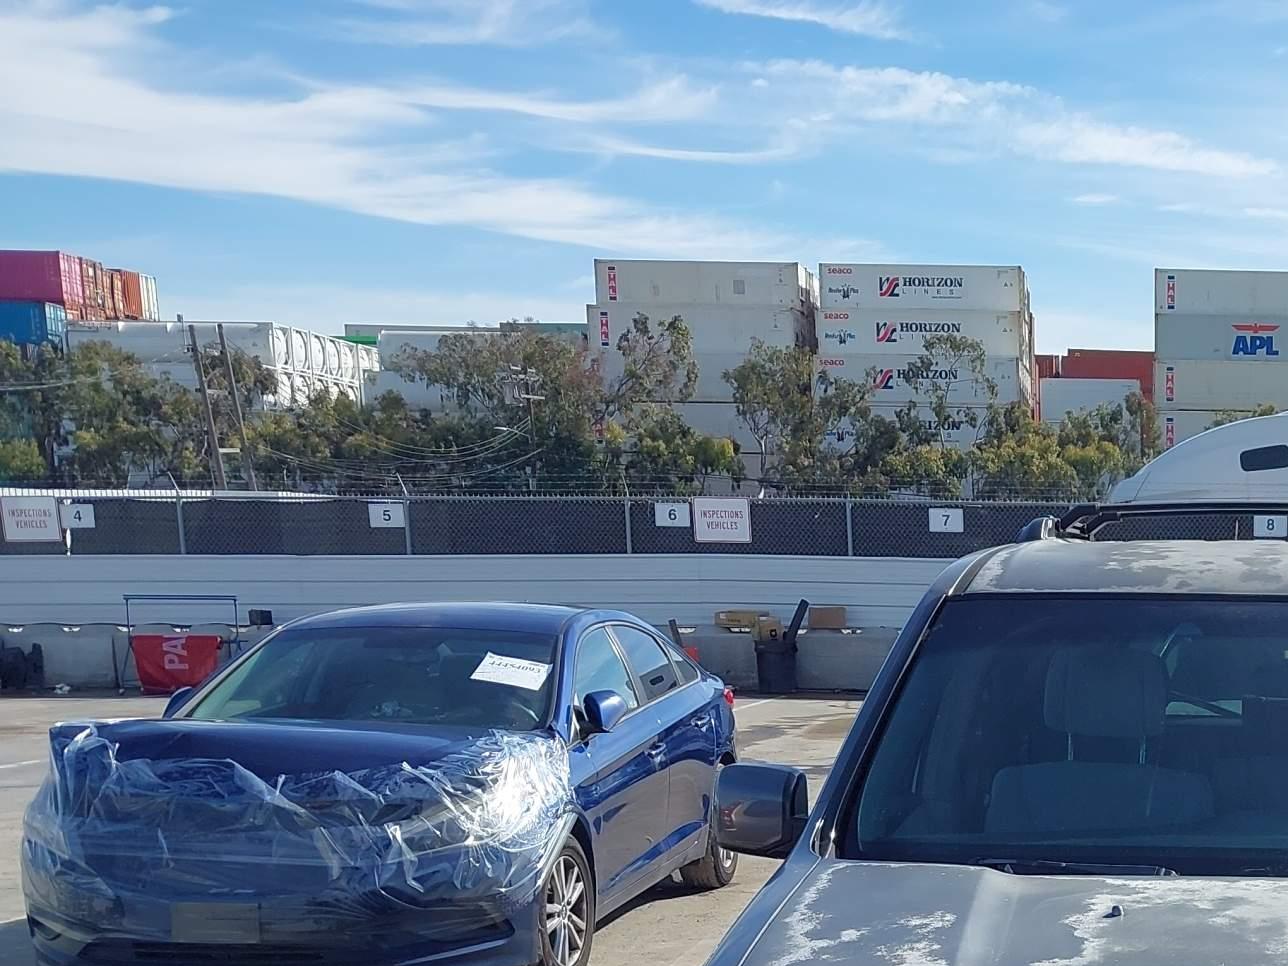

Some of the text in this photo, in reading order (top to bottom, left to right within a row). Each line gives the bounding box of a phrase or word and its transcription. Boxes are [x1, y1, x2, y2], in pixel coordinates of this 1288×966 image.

[827, 267, 853, 275] seaco
[902, 276, 964, 288] HORIZON
[823, 312, 849, 320] seaco
[900, 322, 962, 333] HORIZON
[1231, 335, 1280, 356] APL
[818, 358, 845, 366] seaco
[8, 508, 53, 518] INSPECTIONS
[73, 510, 82, 522] 4
[383, 509, 391, 521] 5
[668, 508, 677, 521] 6
[700, 509, 744, 519] INSPECTIONS
[15, 519, 48, 529] VEHICLES
[706, 521, 739, 530] VEHICLES
[942, 514, 950, 526] 7
[1266, 518, 1275, 531] 8
[163, 634, 189, 670] PA
